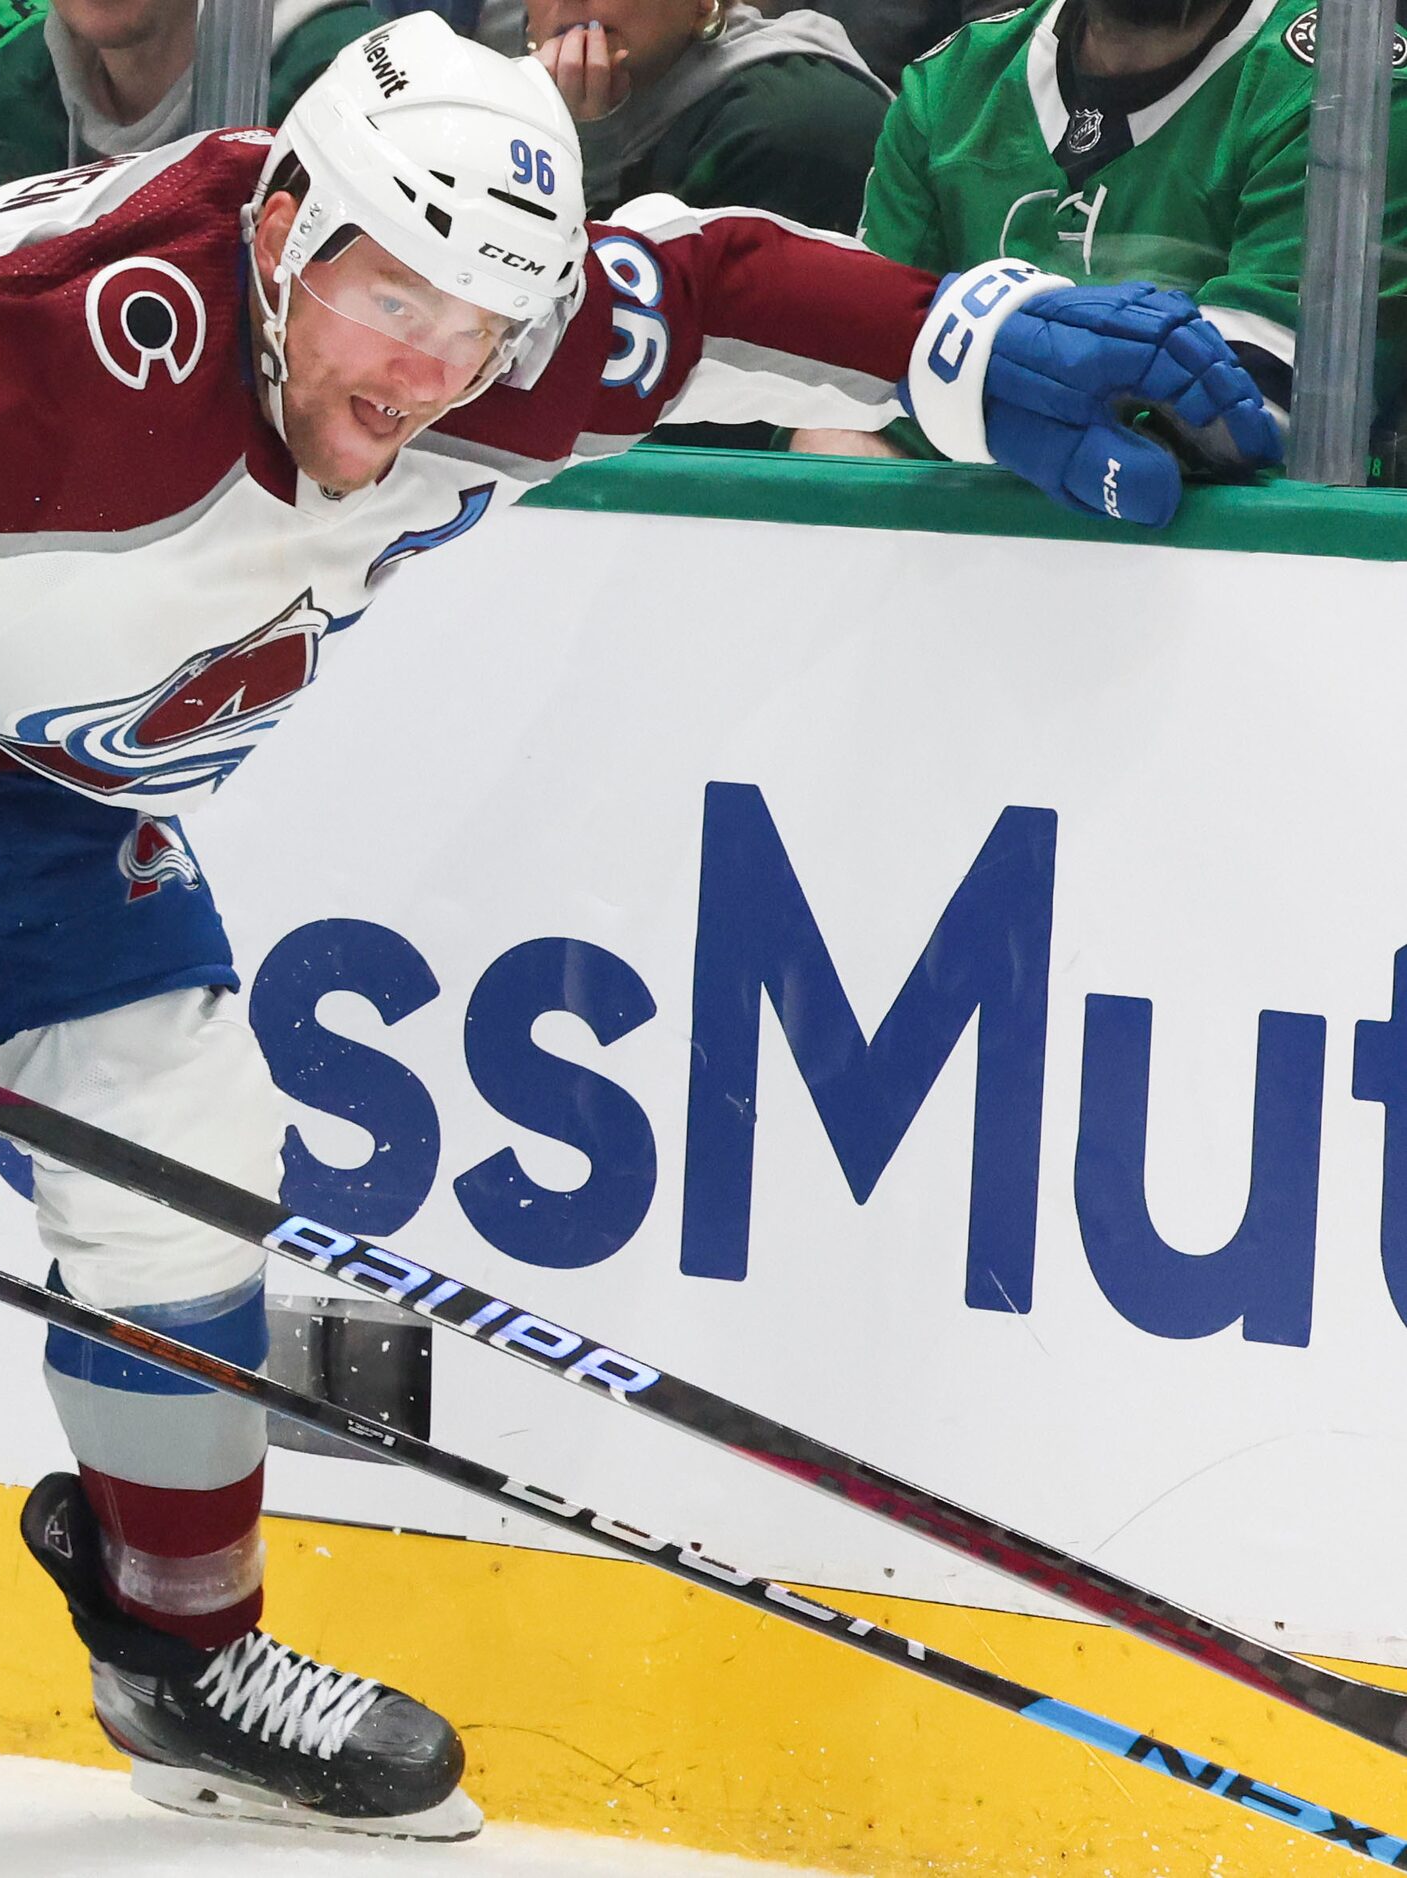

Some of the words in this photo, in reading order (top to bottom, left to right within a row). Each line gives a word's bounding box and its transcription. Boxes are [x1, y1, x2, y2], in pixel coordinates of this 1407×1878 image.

[510, 139, 556, 196] 96
[478, 242, 547, 276] CCM
[927, 267, 1052, 385] CCM
[1102, 457, 1122, 519] CCM
